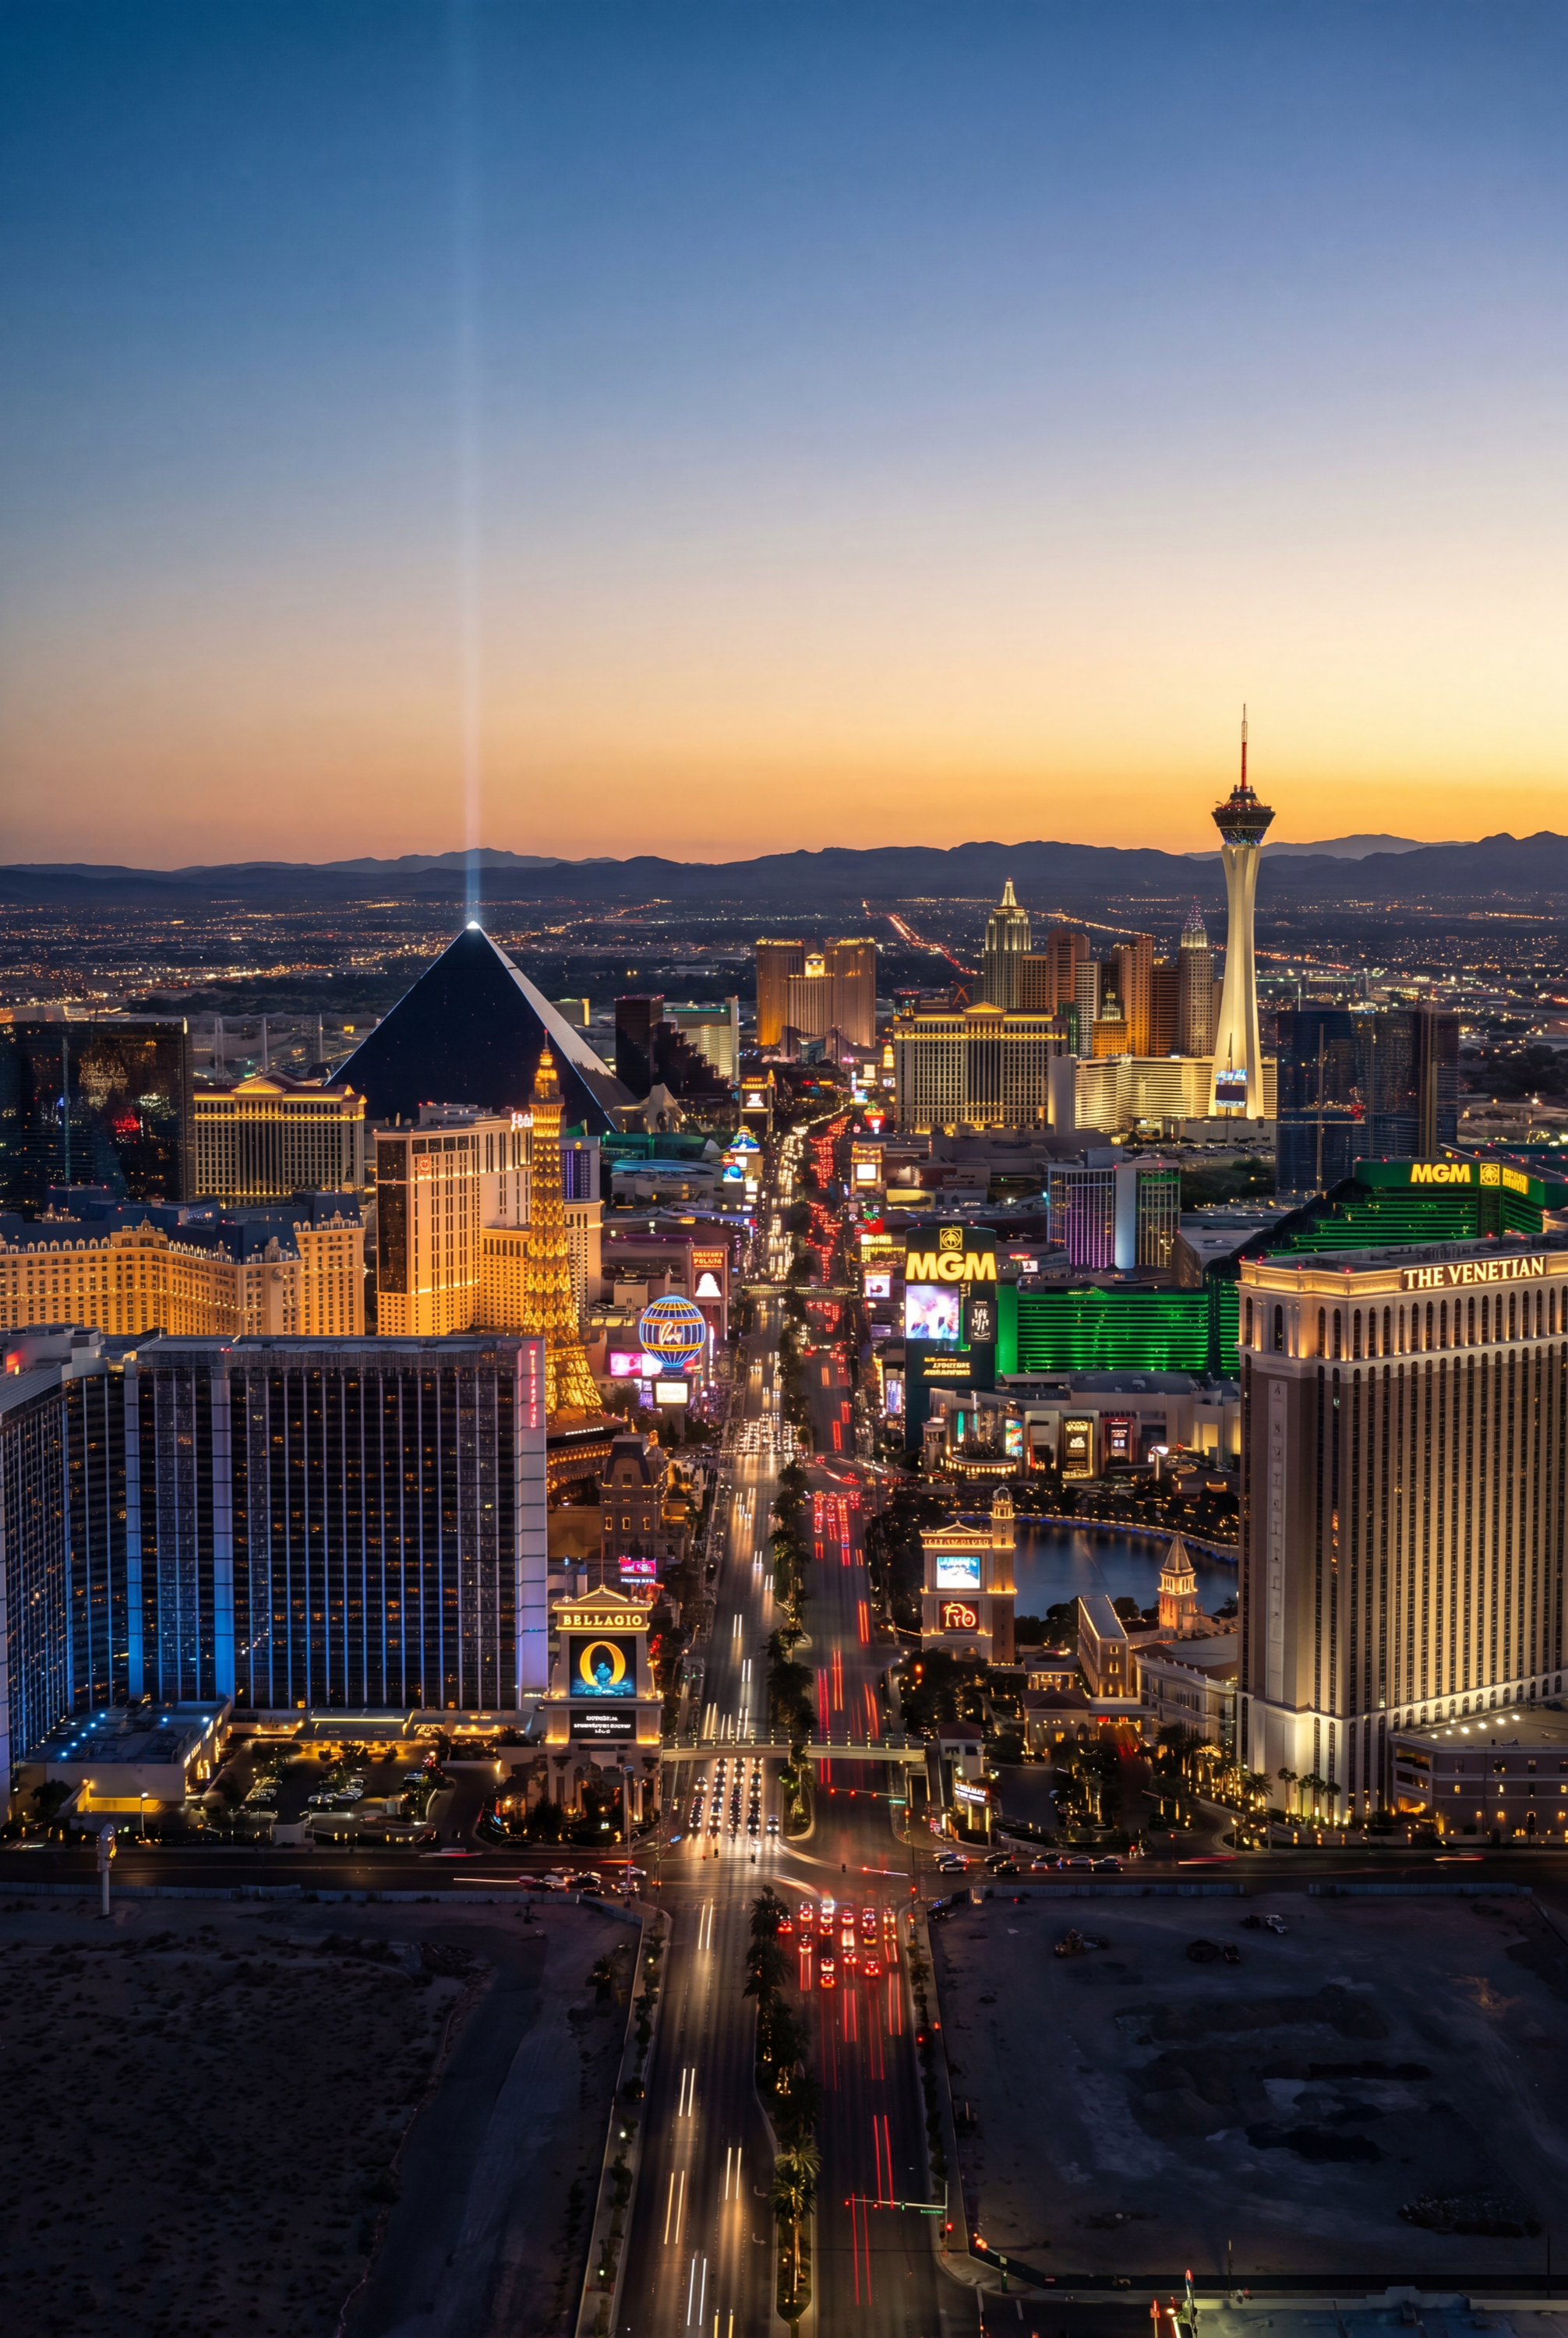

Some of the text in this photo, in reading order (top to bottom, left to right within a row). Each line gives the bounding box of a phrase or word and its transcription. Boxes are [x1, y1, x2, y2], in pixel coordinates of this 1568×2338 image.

[1411, 1164, 1471, 1183] MGM
[905, 1251, 998, 1281] MGM
[1404, 1256, 1545, 1290] THE VENETIAN
[562, 1614, 643, 1626] BELLAGIO
